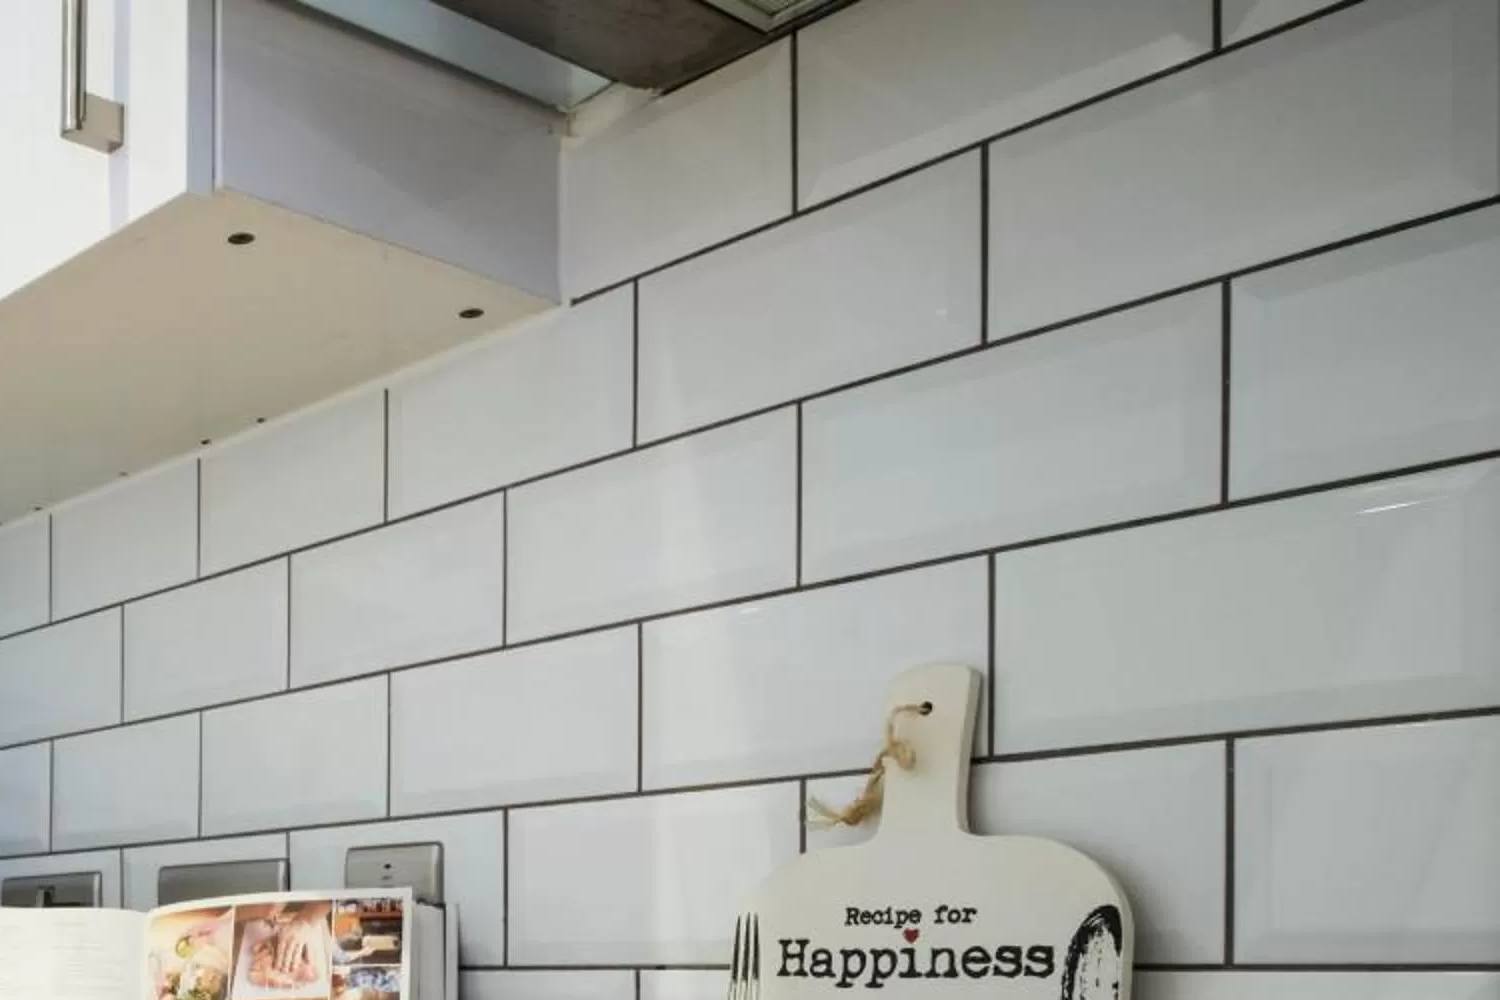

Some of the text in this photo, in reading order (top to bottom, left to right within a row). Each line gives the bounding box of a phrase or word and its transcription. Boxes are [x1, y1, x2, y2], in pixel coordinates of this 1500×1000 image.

[844, 905, 978, 928] Recipe for
[776, 938, 1055, 988] Happiness
